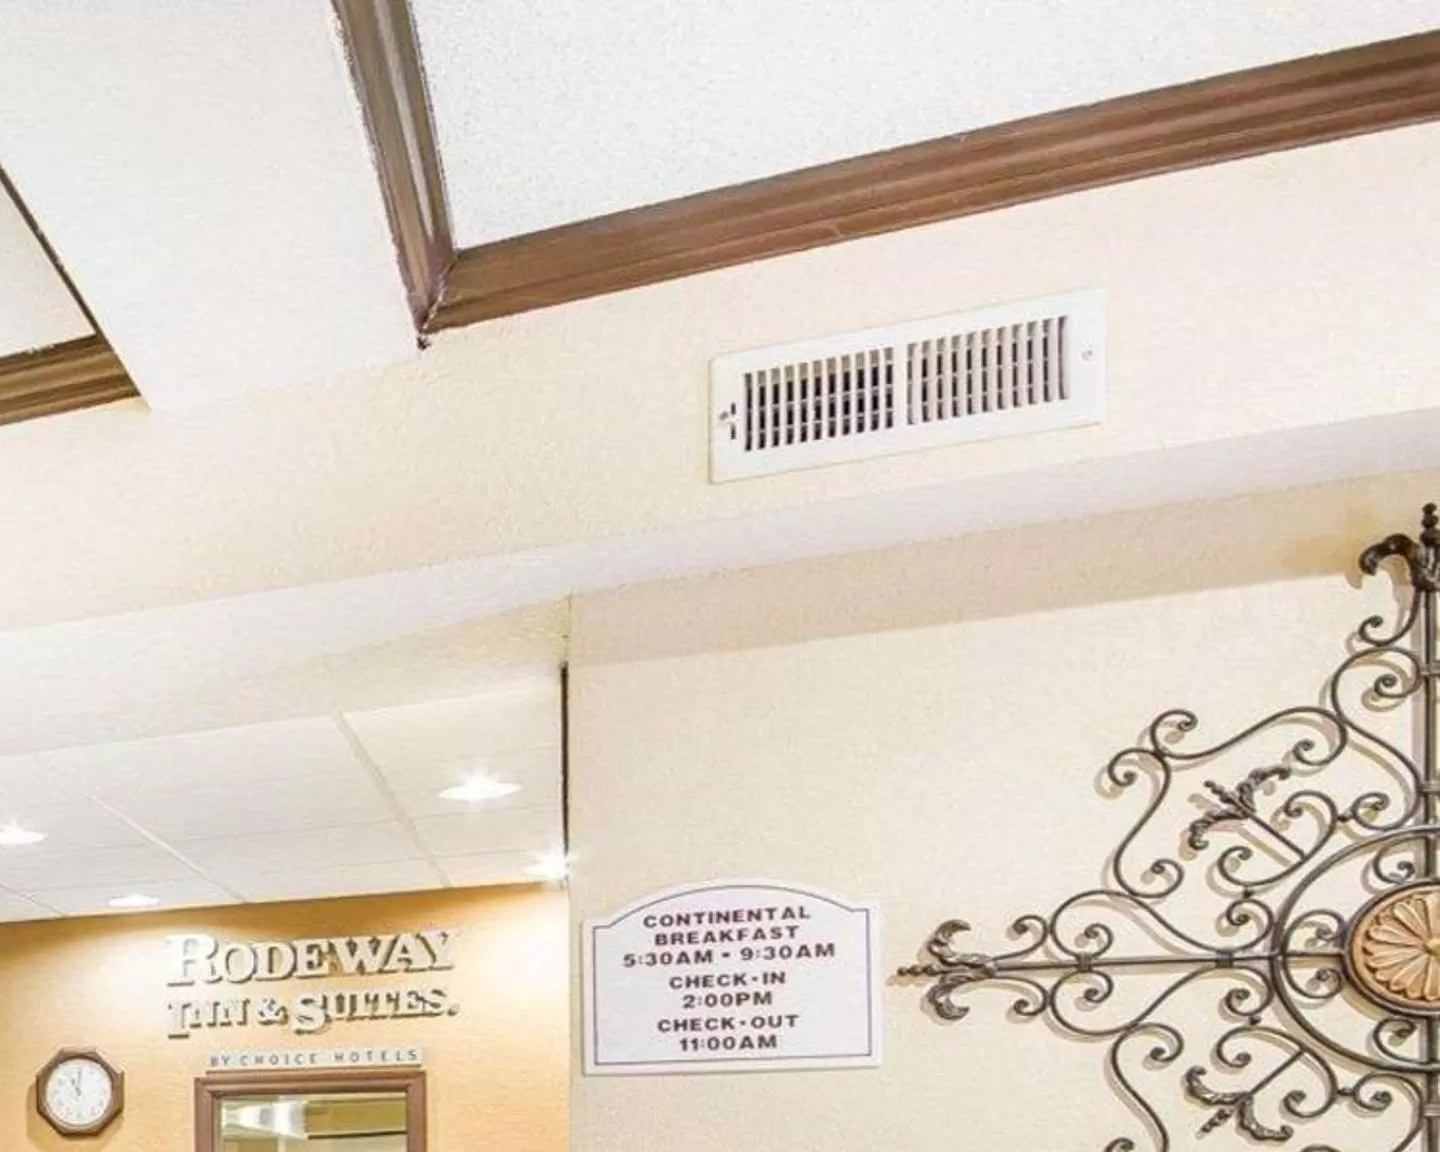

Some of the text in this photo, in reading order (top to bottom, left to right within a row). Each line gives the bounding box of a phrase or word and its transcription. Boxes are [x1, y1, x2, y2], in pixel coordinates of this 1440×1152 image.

[643, 906, 811, 928] CONTINENTAL
[654, 925, 800, 946] BREAKFAST
[165, 931, 457, 986] RODEWAY
[623, 950, 713, 968] 5:30AM
[741, 943, 835, 961] 9:30AM
[682, 991, 772, 1009] 2:00PM
[167, 1000, 252, 1040] INN
[259, 996, 289, 1026] &
[679, 1035, 777, 1051] 11:00AM
[210, 1049, 418, 1067] BY CHOICE HOTELS
